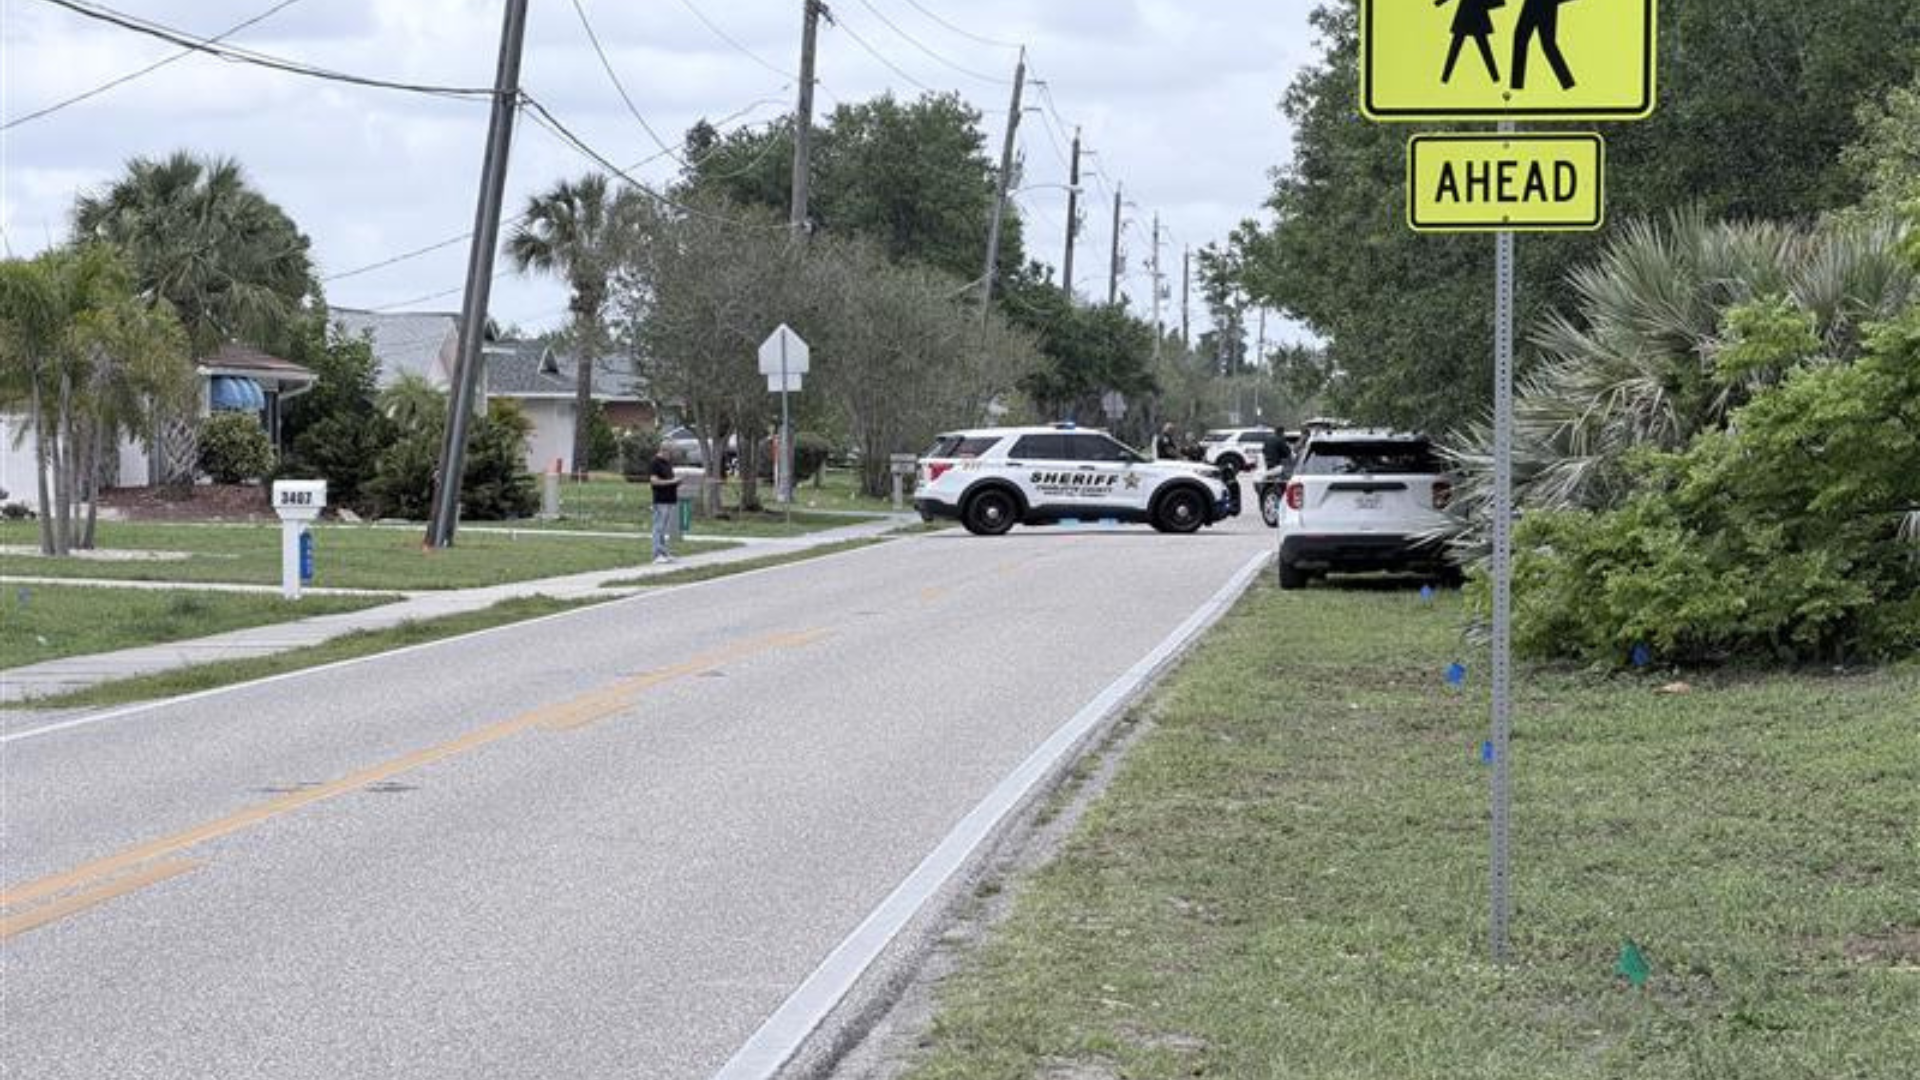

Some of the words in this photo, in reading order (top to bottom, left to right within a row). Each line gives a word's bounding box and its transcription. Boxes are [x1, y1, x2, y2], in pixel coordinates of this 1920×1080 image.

[1434, 160, 1579, 203] AHEAD
[1029, 472, 1119, 486] SHERIFF
[281, 491, 313, 505] 3407
